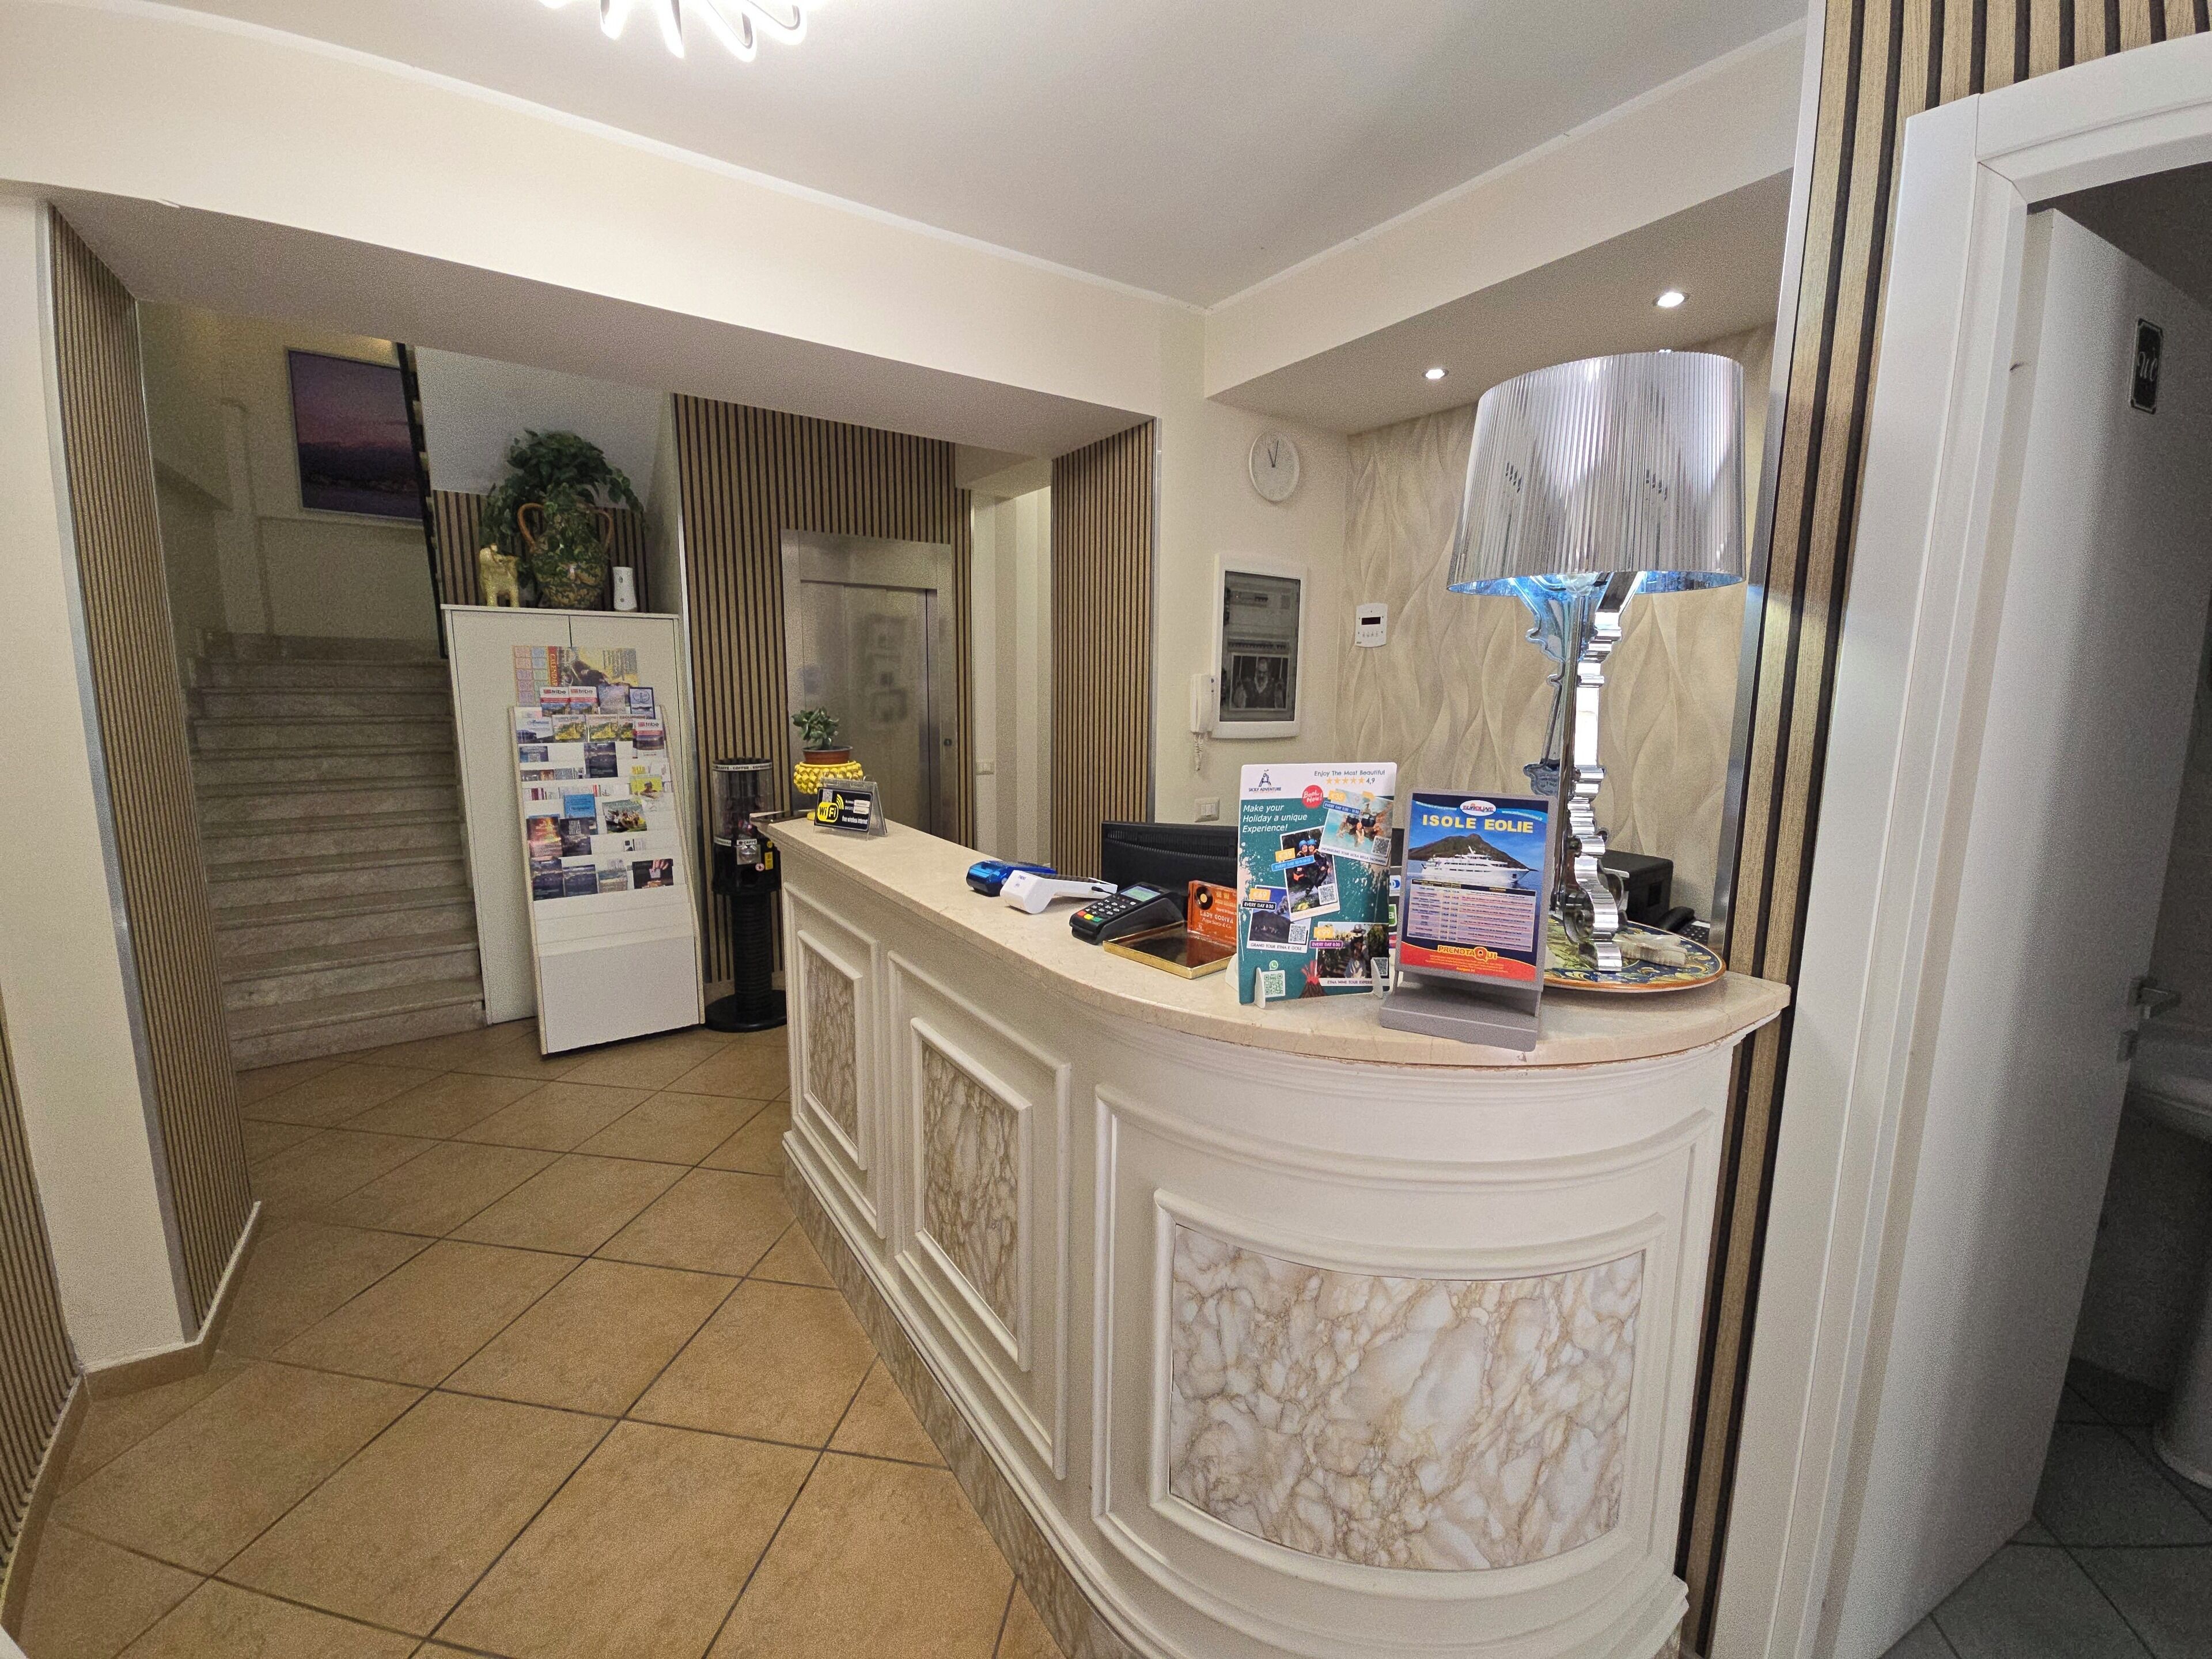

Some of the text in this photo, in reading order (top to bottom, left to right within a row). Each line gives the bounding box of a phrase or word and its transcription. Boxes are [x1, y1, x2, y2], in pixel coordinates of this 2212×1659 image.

[1266, 805, 1284, 815] your
[1243, 815, 1271, 824] Holiday
[1281, 814, 1308, 823] unique
[1422, 815, 1533, 833] ISOLE EOLIE
[1243, 824, 1287, 834] Experience!
[1200, 910, 1213, 918] LADY
[1215, 914, 1233, 924] GODIVA
